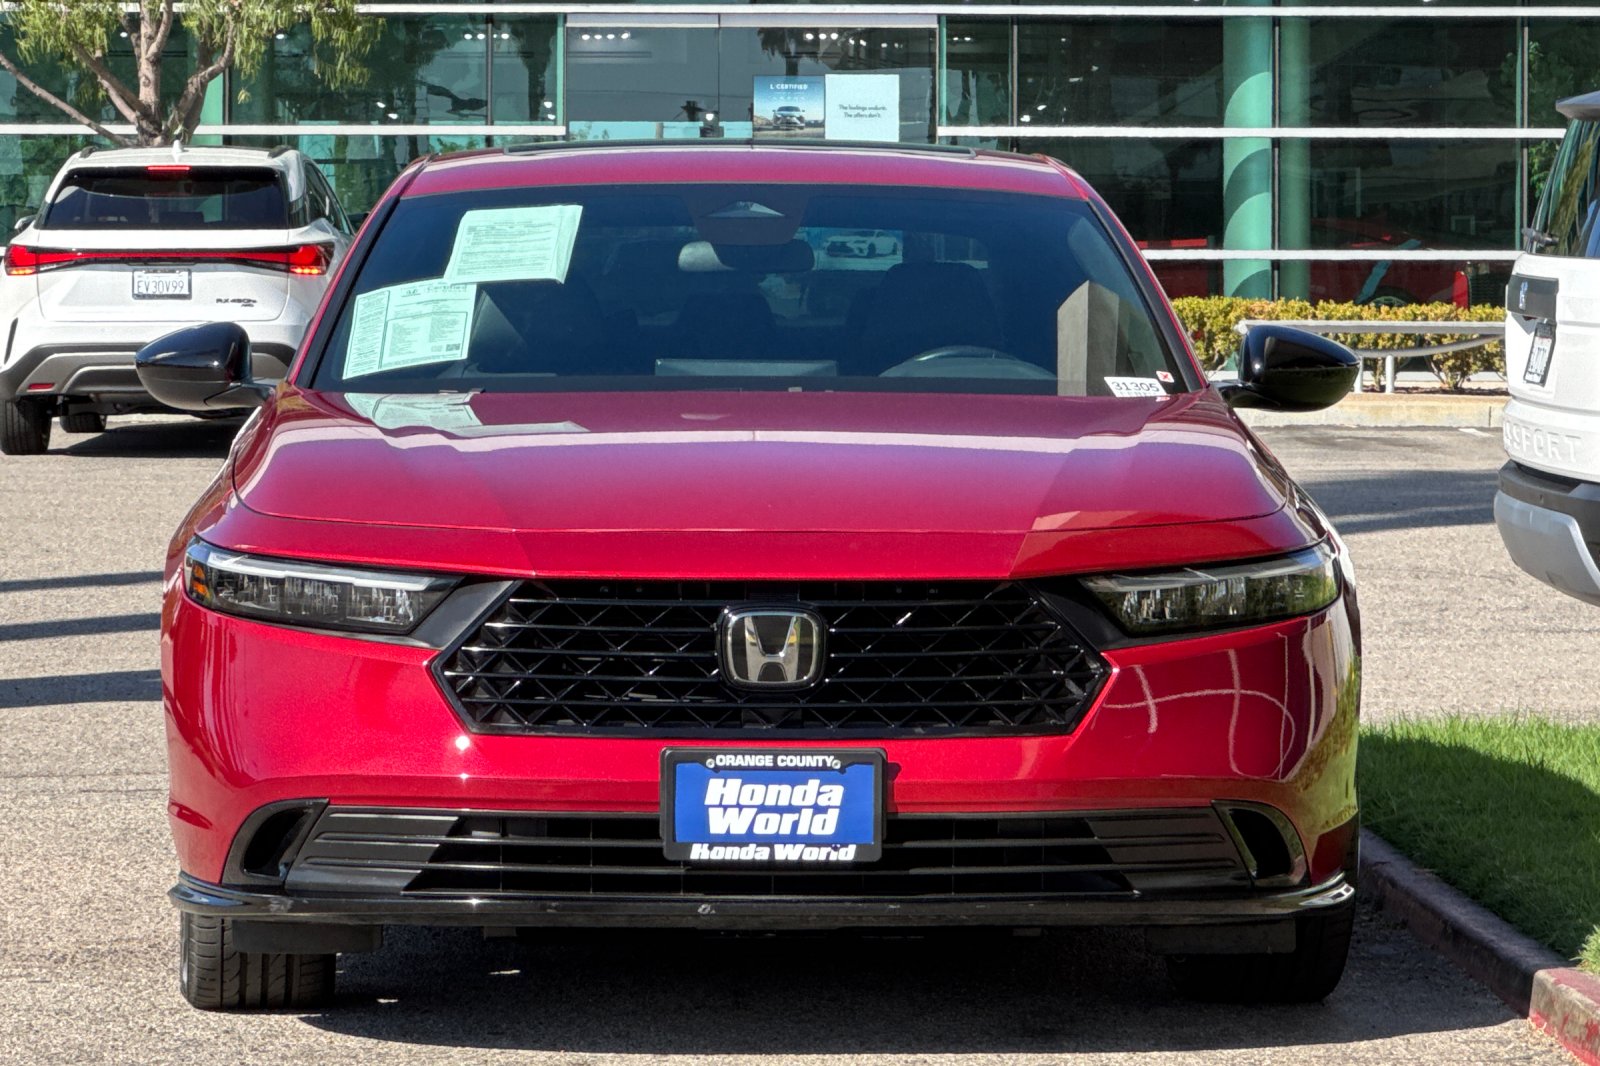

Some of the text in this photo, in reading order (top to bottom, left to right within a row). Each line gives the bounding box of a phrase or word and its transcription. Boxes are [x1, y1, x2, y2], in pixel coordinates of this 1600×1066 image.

[137, 280, 184, 293] EV30V99
[1111, 381, 1160, 392] 31305
[715, 755, 834, 767] ORANGE COUNTY
[704, 778, 845, 807] Honda
[708, 807, 840, 835] World
[690, 844, 857, 861] Honda World
